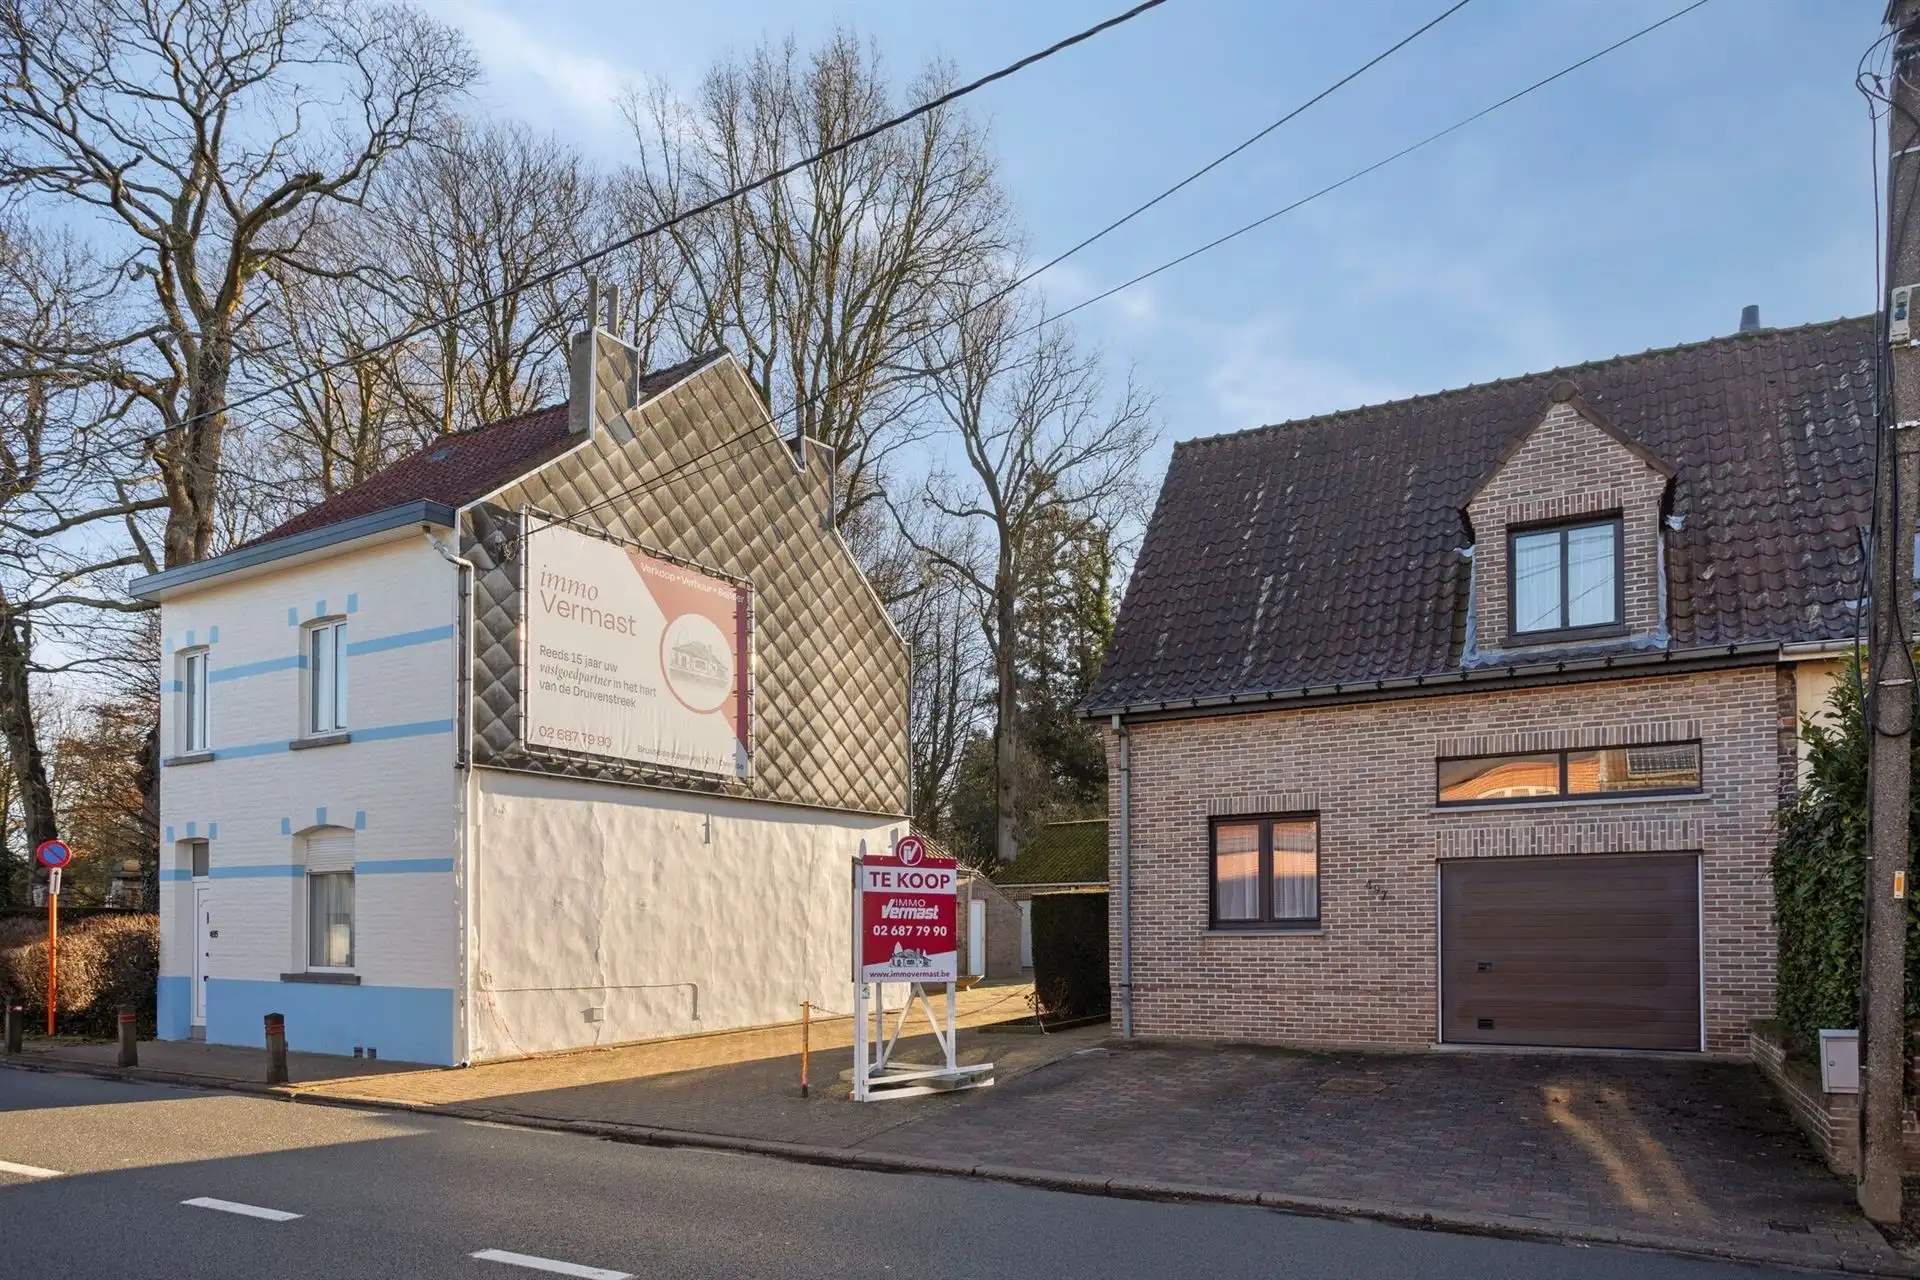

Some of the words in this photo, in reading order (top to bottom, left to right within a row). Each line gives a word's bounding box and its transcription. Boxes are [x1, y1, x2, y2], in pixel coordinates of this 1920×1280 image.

[540, 564, 598, 601] immo
[640, 562, 676, 583] Verkoop
[540, 589, 637, 636] Vermast
[540, 645, 569, 662] Reeds
[571, 652, 583, 665] 15
[584, 656, 603, 669] jaar
[603, 661, 618, 673] uw
[540, 663, 612, 688] vastgoedpartner
[613, 679, 622, 689] in
[623, 680, 638, 694] het
[640, 683, 657, 697] hart
[539, 680, 557, 693] van
[559, 683, 571, 695] de
[573, 685, 637, 708] Druivenstreek
[539, 725, 555, 739] 02
[557, 728, 579, 742] 687
[581, 732, 595, 745] 79
[597, 735, 612, 748] 90
[869, 871, 892, 888] TE
[897, 872, 951, 889] KOOP
[1365, 879, 1388, 901] 497
[881, 898, 939, 920] Vermast
[895, 898, 926, 908] IMMO
[873, 925, 888, 936] 02
[890, 925, 913, 936] 687
[916, 925, 931, 937] 79
[933, 926, 948, 937] 90
[869, 970, 951, 978] www.immovermast.be
